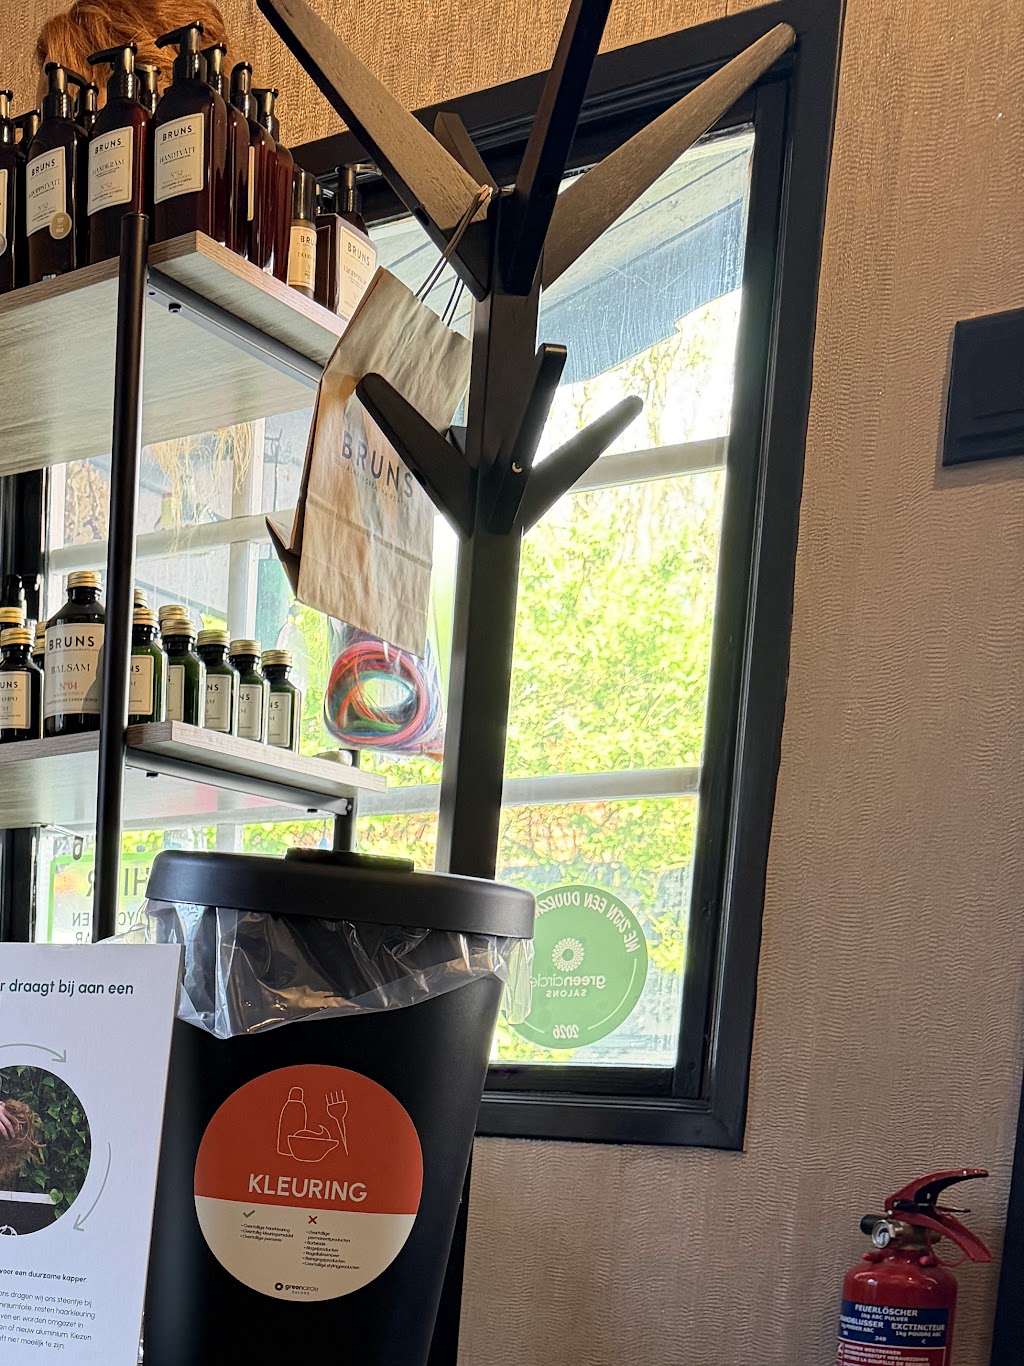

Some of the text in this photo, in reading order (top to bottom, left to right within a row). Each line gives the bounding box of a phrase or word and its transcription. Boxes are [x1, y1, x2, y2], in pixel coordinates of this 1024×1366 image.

[162, 125, 193, 142] BRUNS
[94, 138, 122, 154] BRUNS
[31, 158, 56, 176] BRUNS
[347, 242, 370, 266] BRUNS
[342, 431, 413, 498] BRUNS
[49, 636, 95, 651] BRUNS
[50, 663, 90, 674] BALSAM
[9, 979, 55, 996] draagt
[58, 980, 75, 997] bij
[78, 983, 104, 994] aan
[108, 984, 134, 994] een
[248, 1174, 368, 1202] KLEURING
[0, 1268, 14, 1276] voor
[28, 1270, 61, 1280] duurzame
[62, 1274, 88, 1284] kapper.
[56, 1306, 96, 1320] haarkleuring
[854, 1304, 918, 1317] FEUERLÖSCHER
[22, 1314, 46, 1324] worden
[8, 1324, 16, 1332] of
[16, 1326, 35, 1335] nieuw
[70, 1332, 92, 1342] Kiezen
